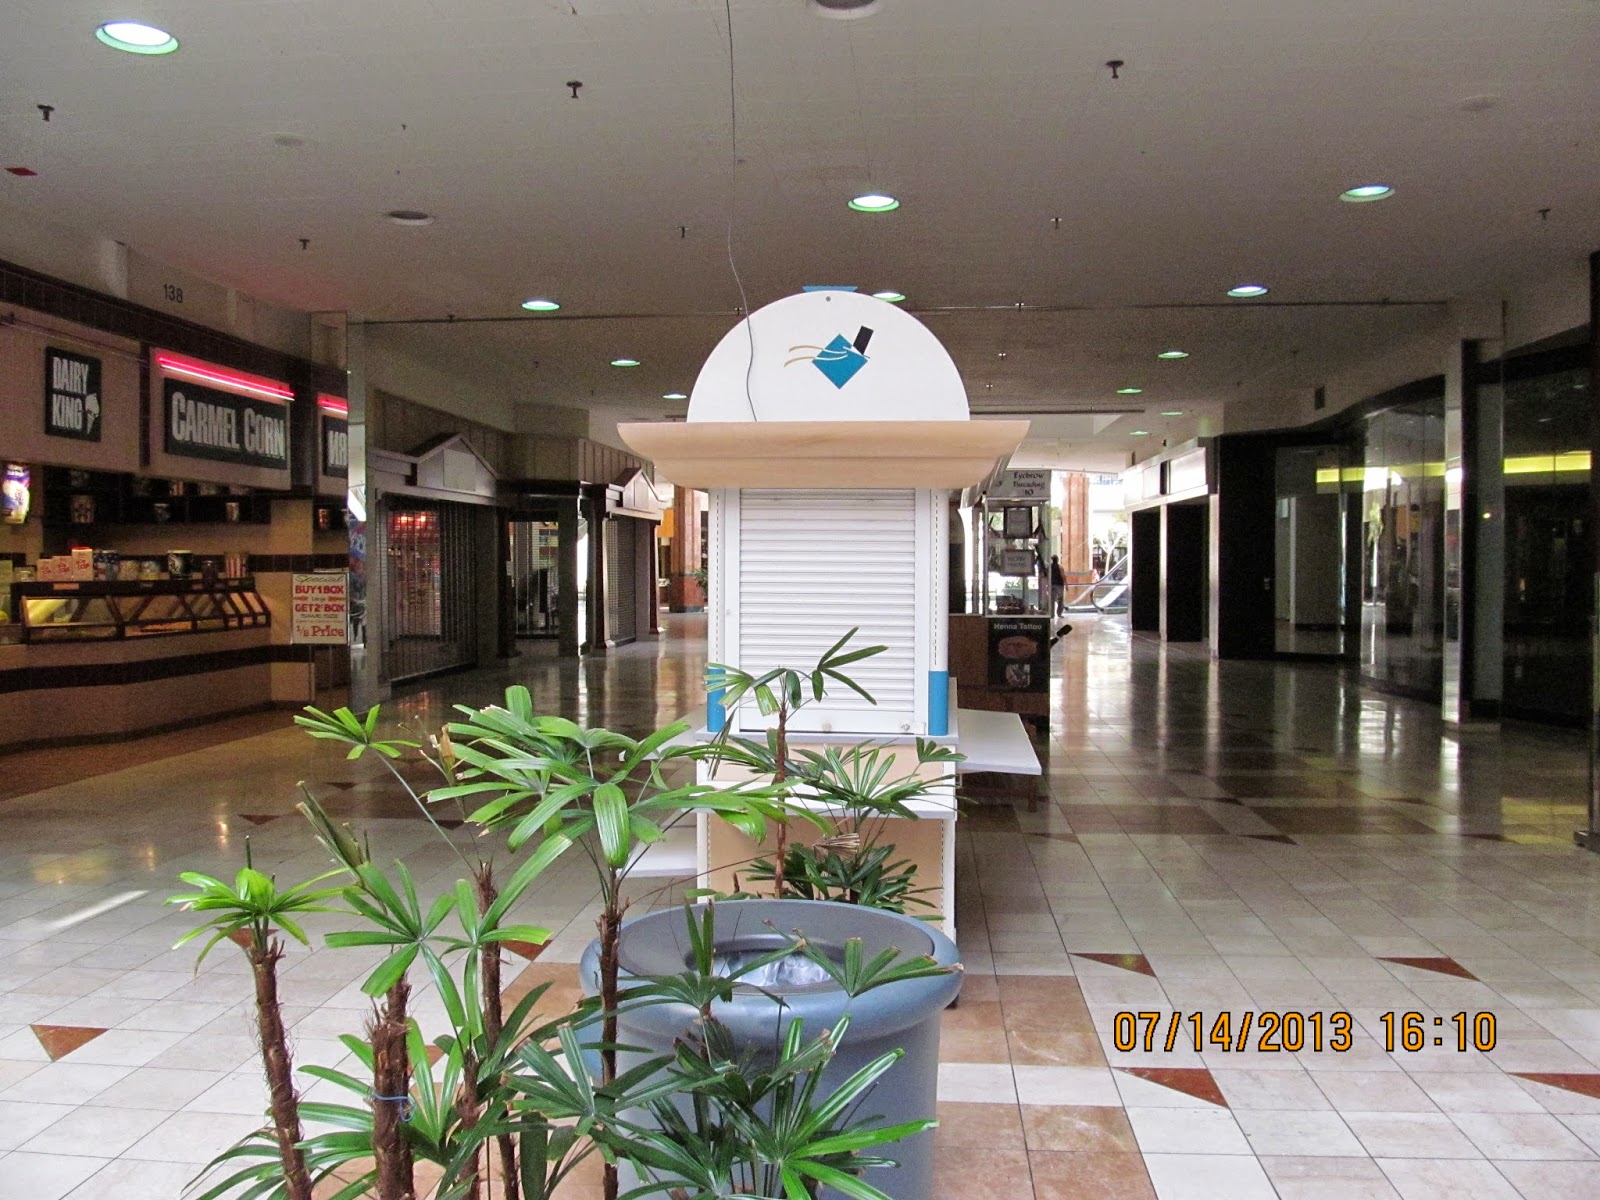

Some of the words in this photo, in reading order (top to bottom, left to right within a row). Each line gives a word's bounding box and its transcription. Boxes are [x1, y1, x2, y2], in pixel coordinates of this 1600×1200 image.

[163, 283, 183, 303] 138
[53, 356, 89, 395] DAIRY
[52, 393, 83, 430] KING
[172, 391, 240, 450] CARMEL
[244, 407, 286, 460] CORN
[295, 585, 315, 594] BUY
[317, 585, 322, 594] 1
[323, 585, 344, 594] BOX
[295, 604, 314, 612] GET
[324, 604, 345, 612] BOX
[311, 624, 345, 637] Price
[994, 622, 1018, 630] Henna
[1019, 622, 1043, 630] Tattoo
